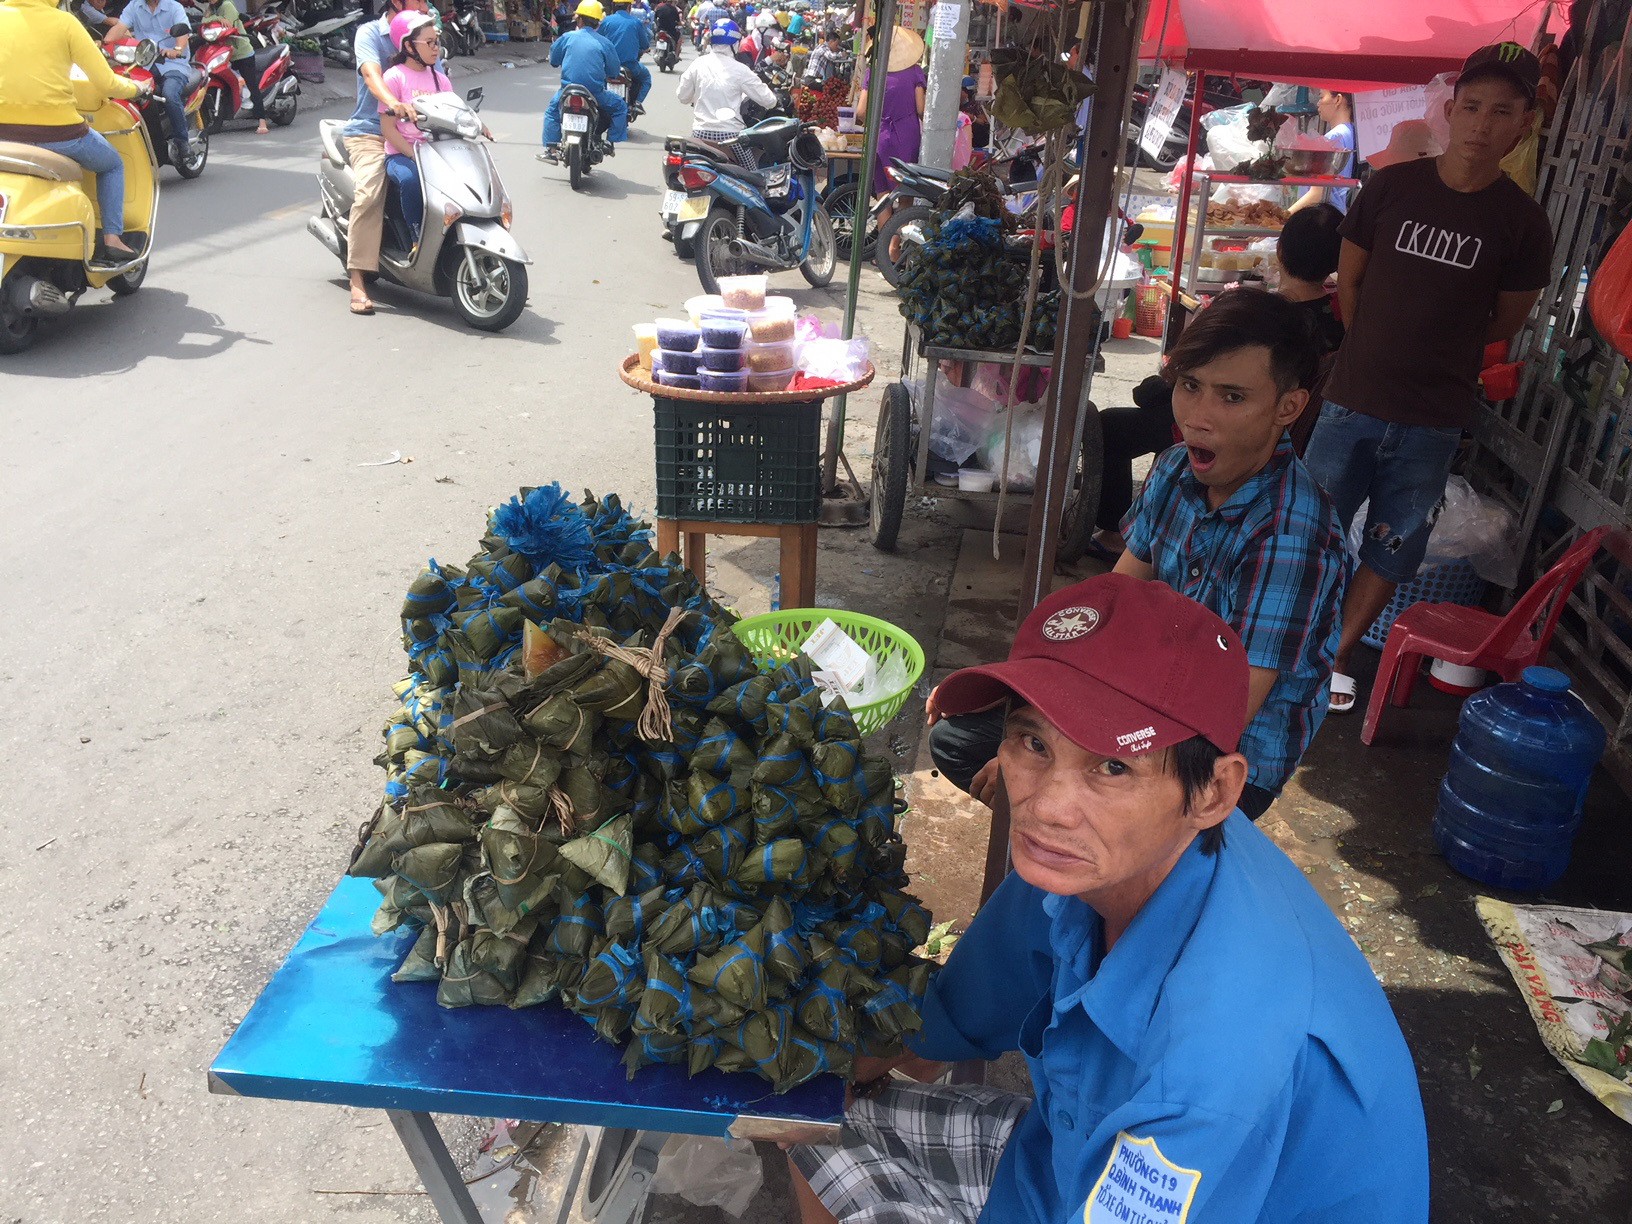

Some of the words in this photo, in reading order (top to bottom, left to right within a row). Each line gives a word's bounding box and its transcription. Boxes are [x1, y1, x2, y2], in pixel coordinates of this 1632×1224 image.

[1116, 726, 1157, 746] CONVERSE
[1118, 1144, 1160, 1184] PHƯỜNG
[1161, 1173, 1178, 1192] 19
[1139, 1185, 1183, 1216] THẠNH
